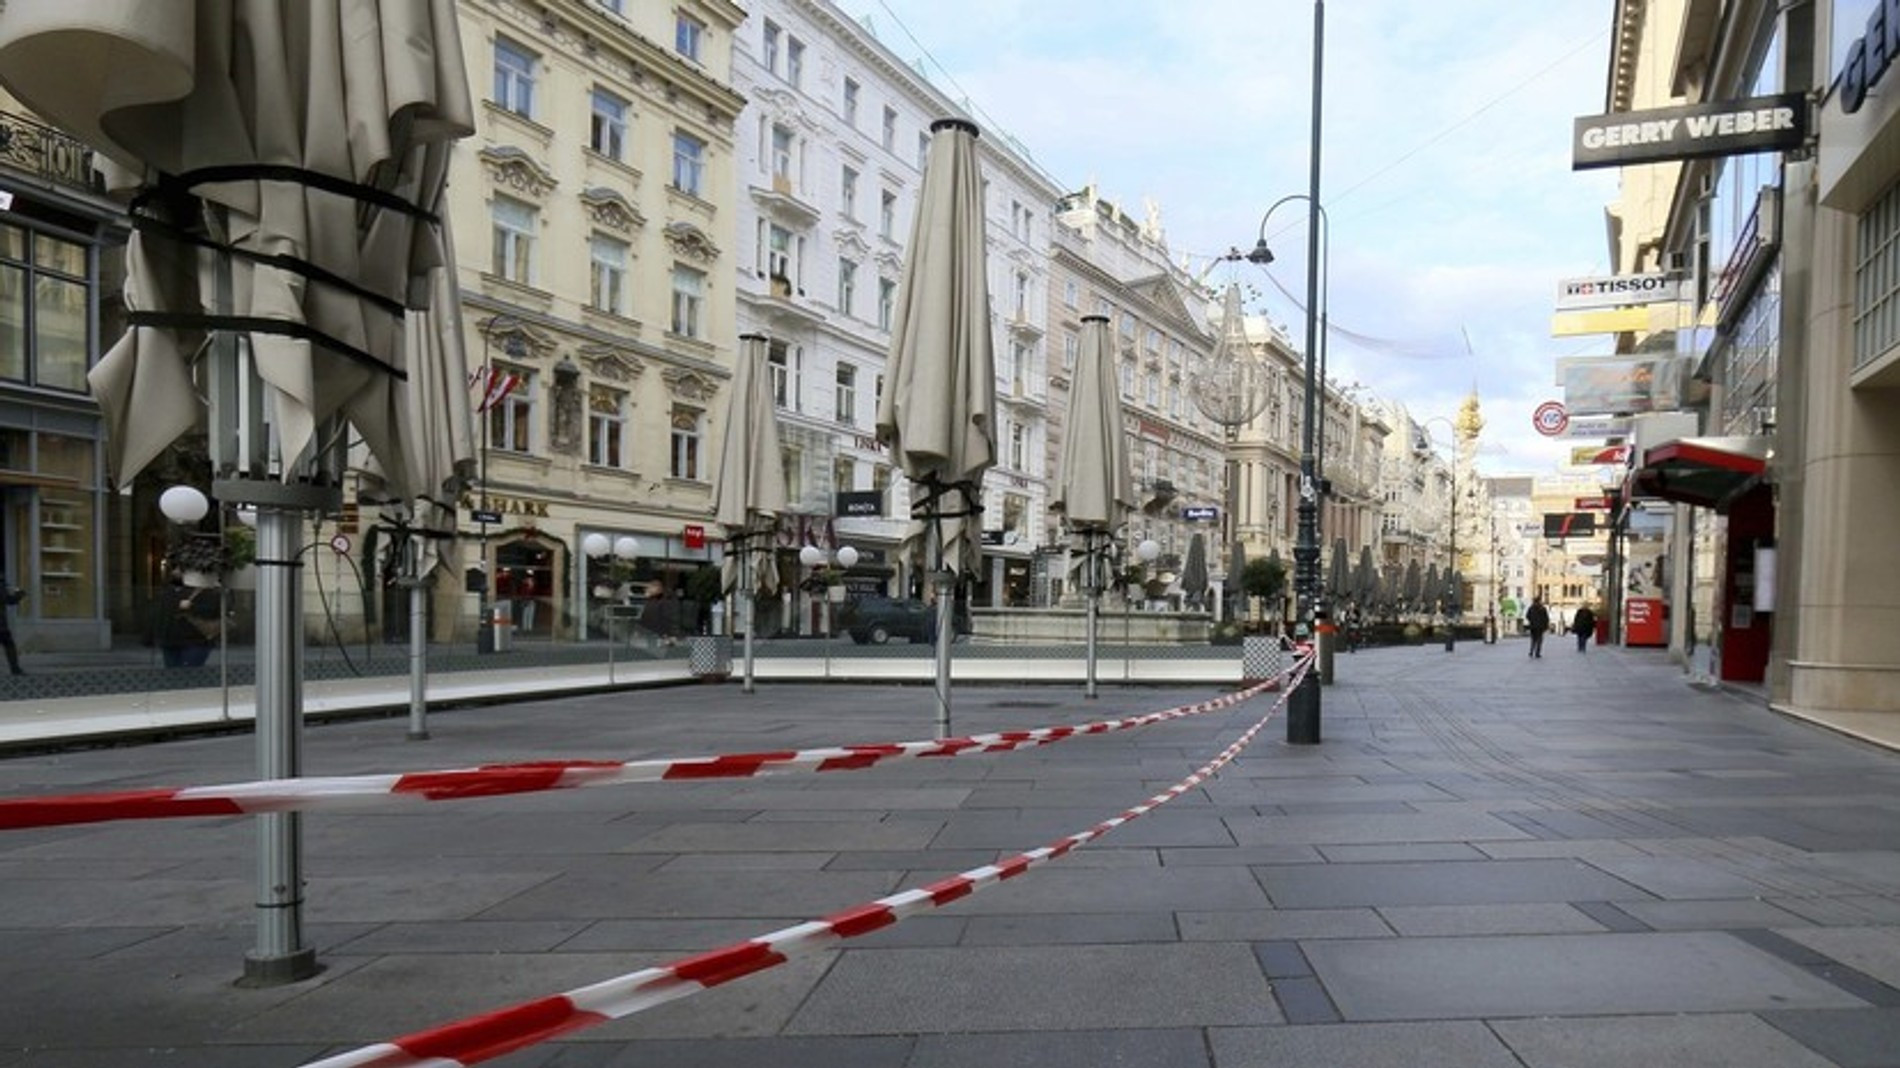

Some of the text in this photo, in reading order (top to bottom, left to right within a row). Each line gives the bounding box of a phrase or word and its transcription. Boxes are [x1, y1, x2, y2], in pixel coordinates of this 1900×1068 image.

[1582, 107, 1794, 149] GERRY WEBER
[1597, 277, 1666, 294] TISSOT
